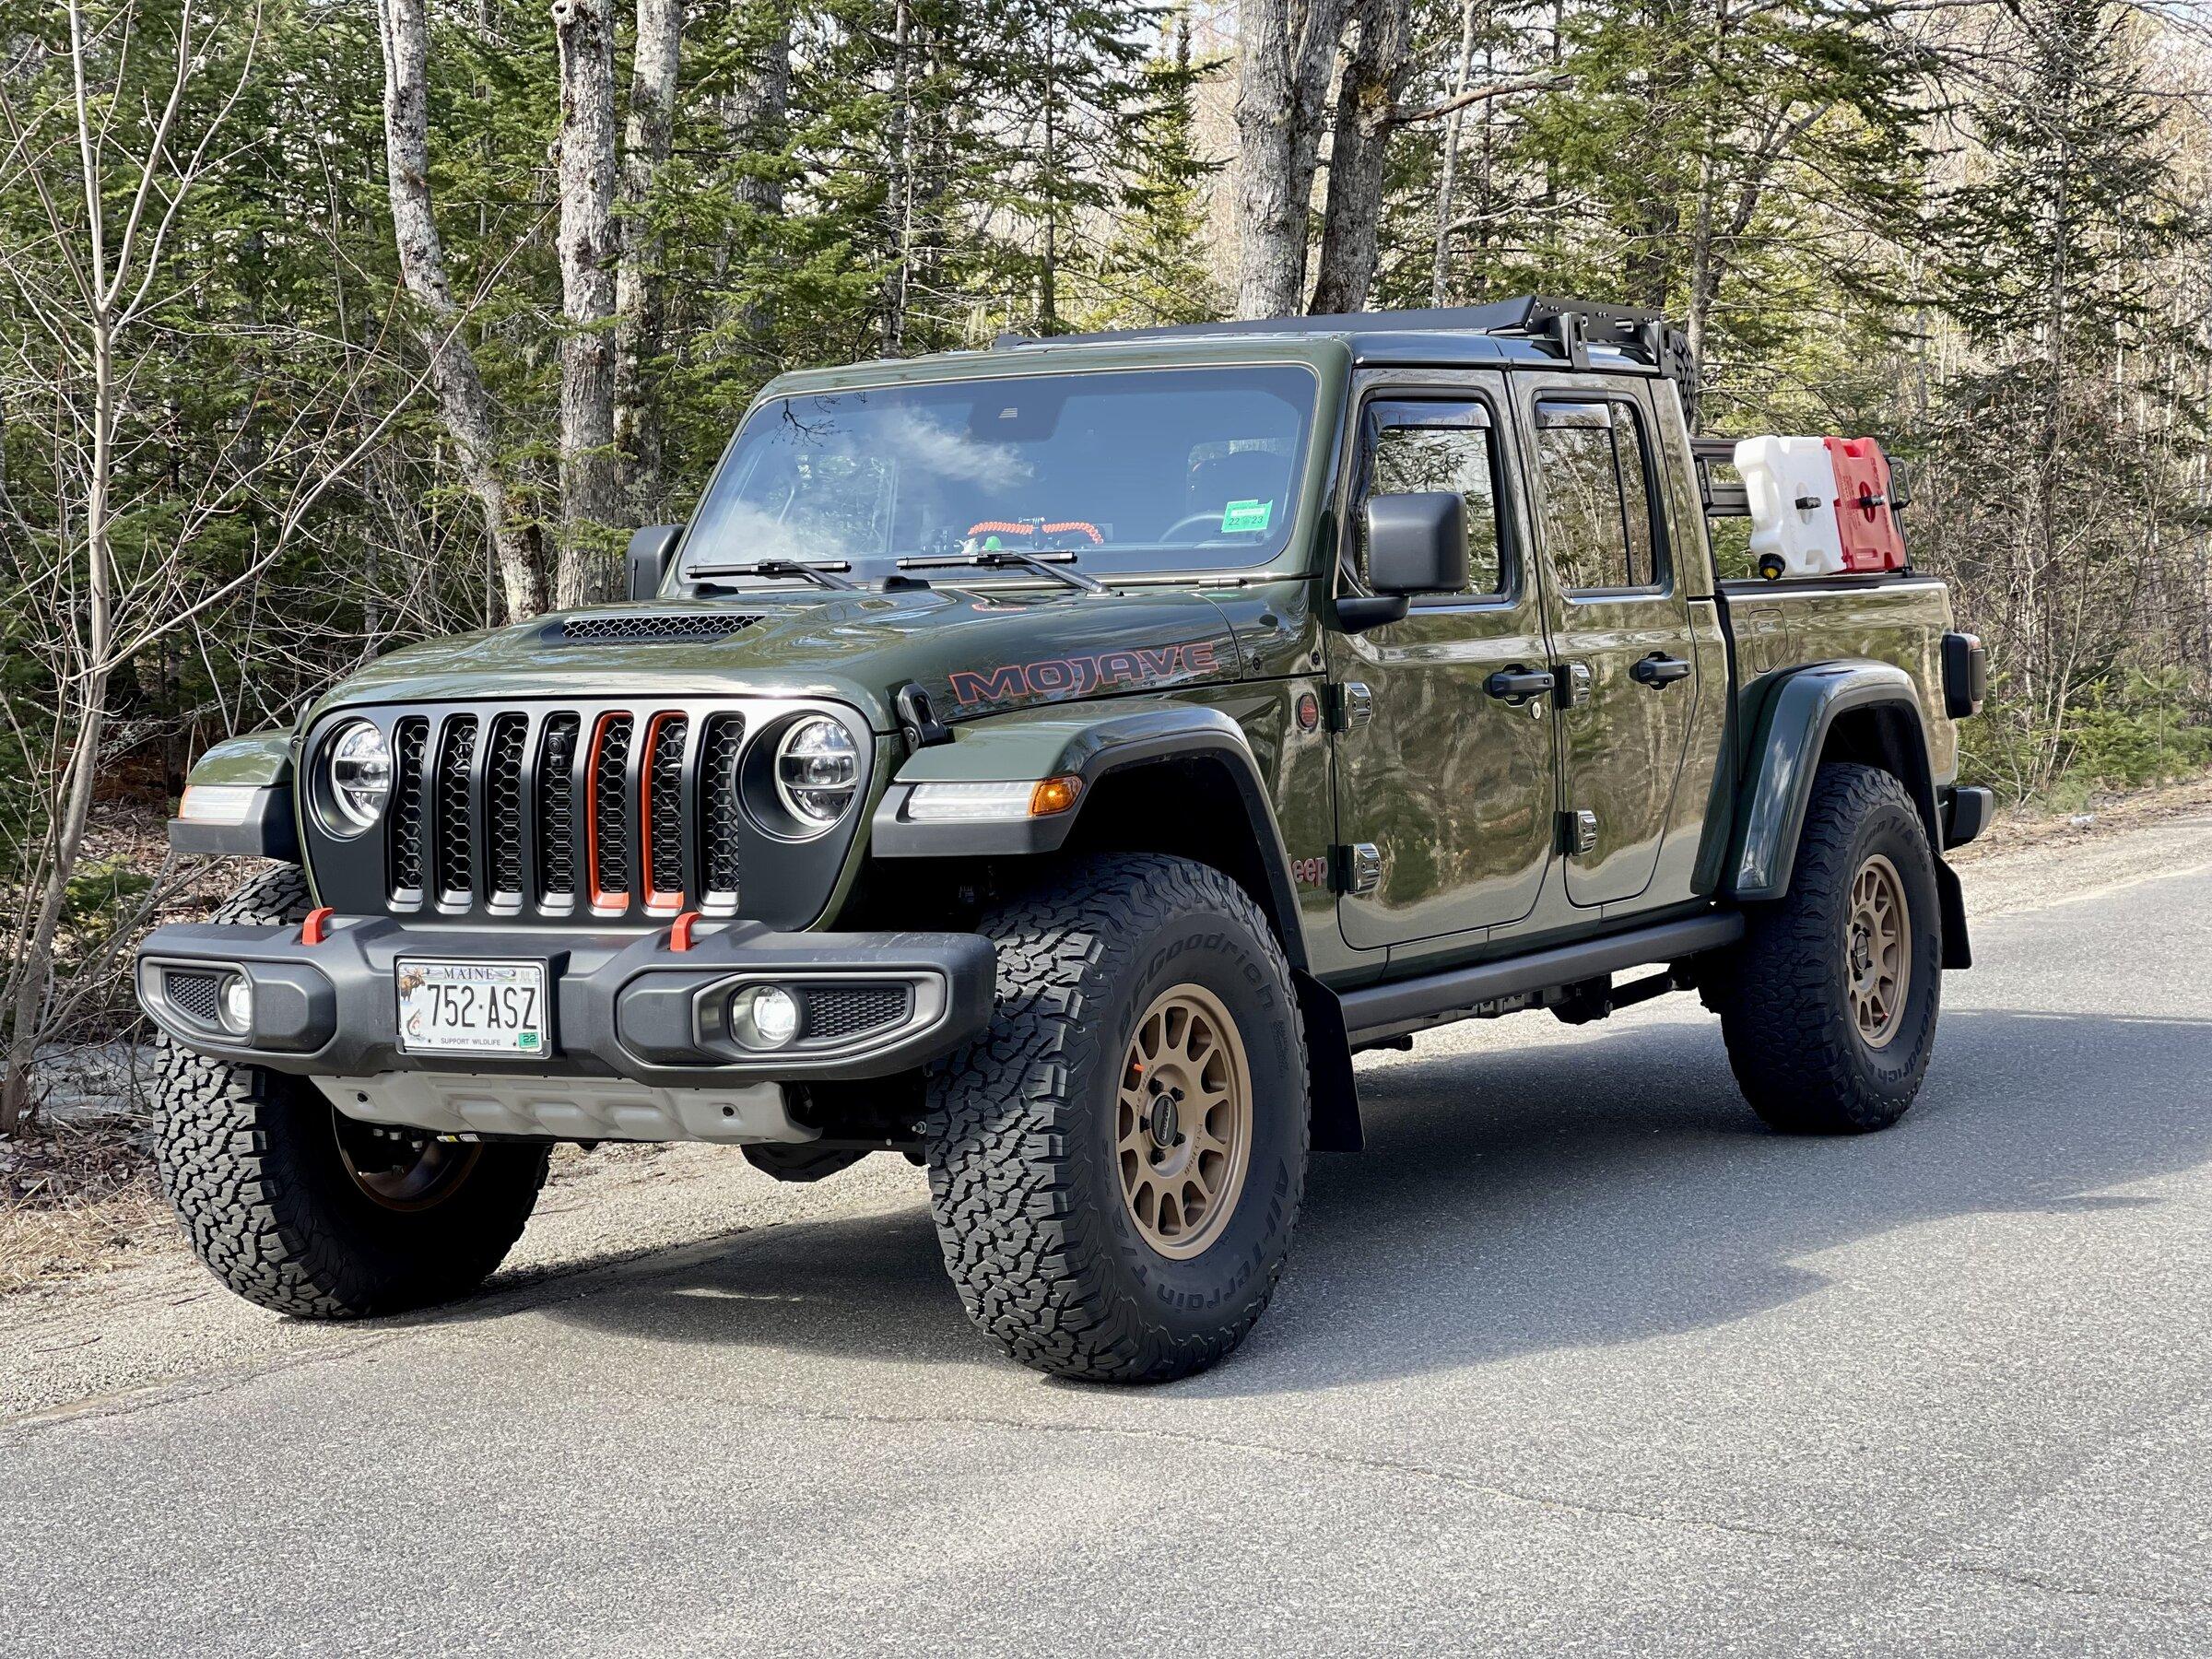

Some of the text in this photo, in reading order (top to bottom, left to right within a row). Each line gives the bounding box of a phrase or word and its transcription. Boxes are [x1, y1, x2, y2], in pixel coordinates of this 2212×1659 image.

[1228, 515, 1264, 526] 22 23
[948, 642, 1219, 705] MOJAVE
[1290, 856, 1329, 888] eep
[443, 968, 495, 981] MAINE
[1119, 932, 1275, 1049] BFGoodrich
[441, 1037, 501, 1047] SUPPORT WILDLIFE
[523, 1035, 537, 1043] 22
[1112, 1205, 1148, 1288] T/A
[1156, 1157, 1289, 1314] All-Terrain
